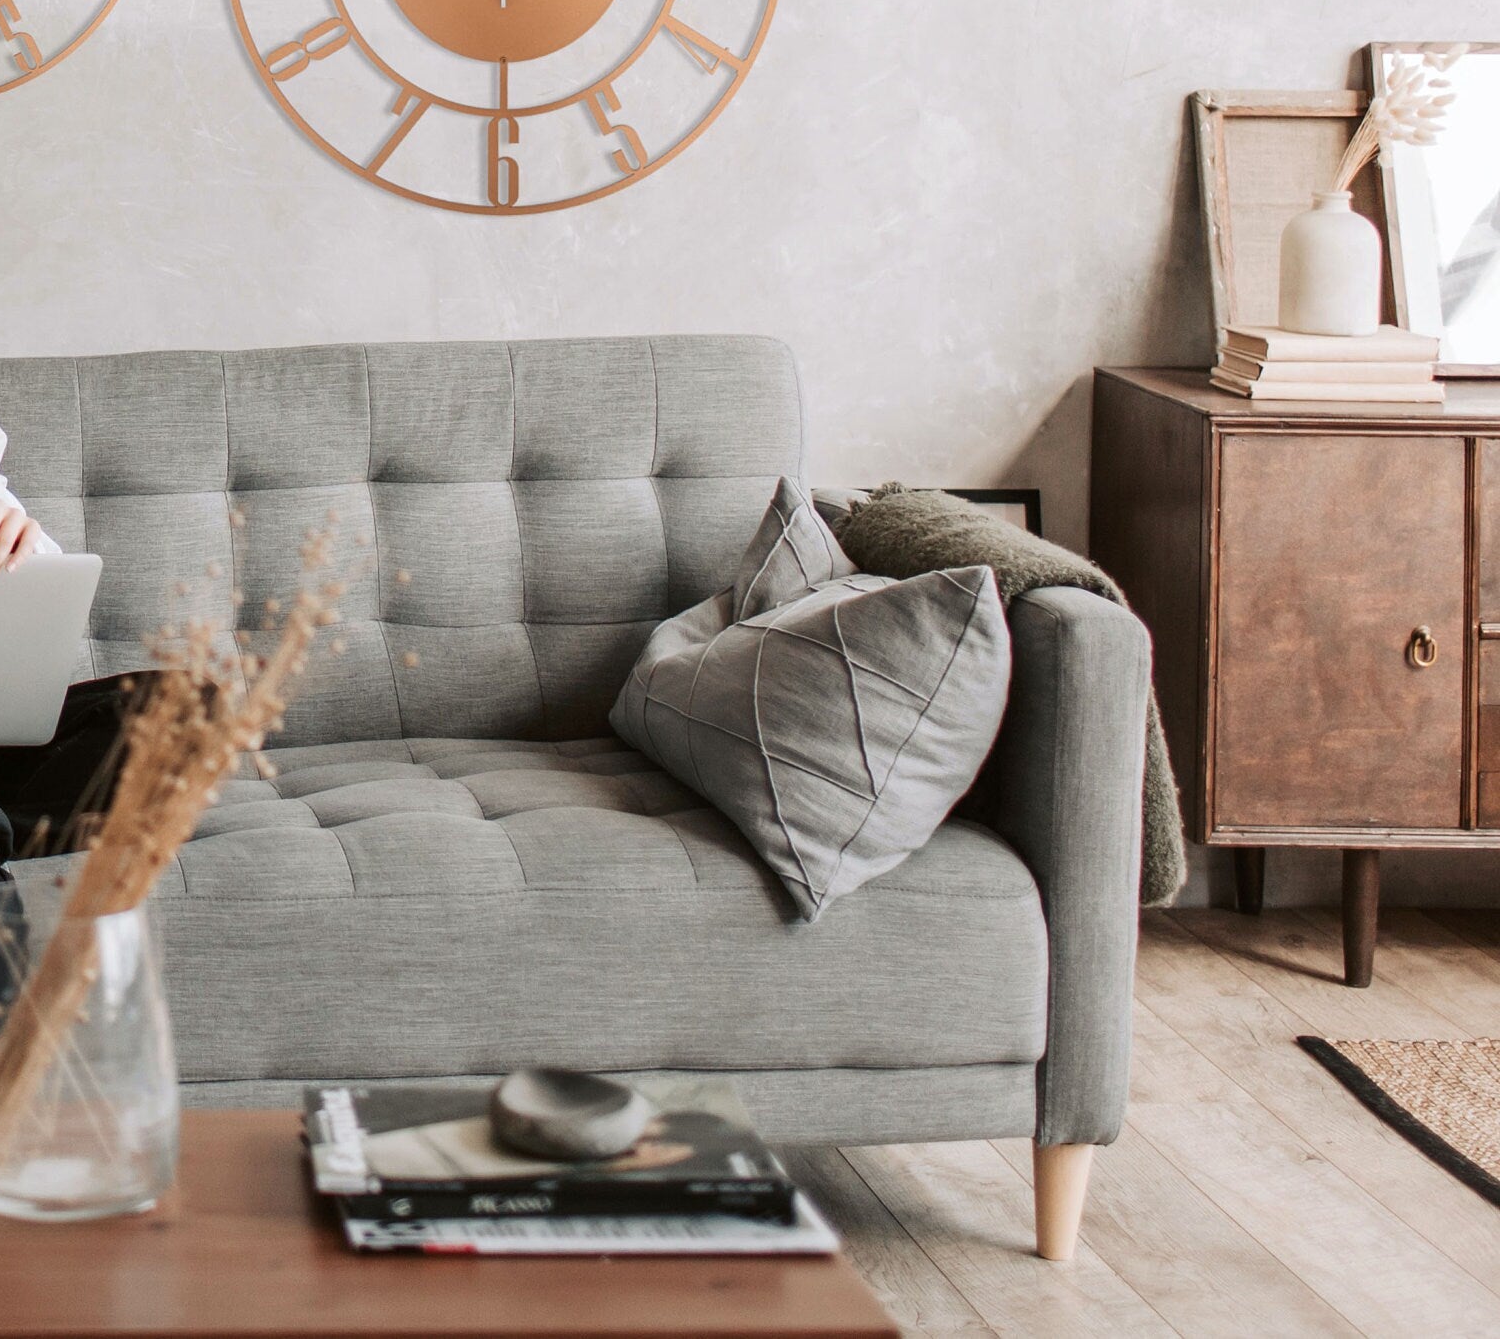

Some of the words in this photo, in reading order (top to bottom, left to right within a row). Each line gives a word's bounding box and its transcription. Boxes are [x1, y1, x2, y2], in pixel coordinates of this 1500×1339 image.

[268, 16, 353, 82] 8
[660, 14, 750, 75] 4
[364, 83, 431, 176] 7
[487, 116, 520, 207] 6
[584, 81, 649, 175] 5
